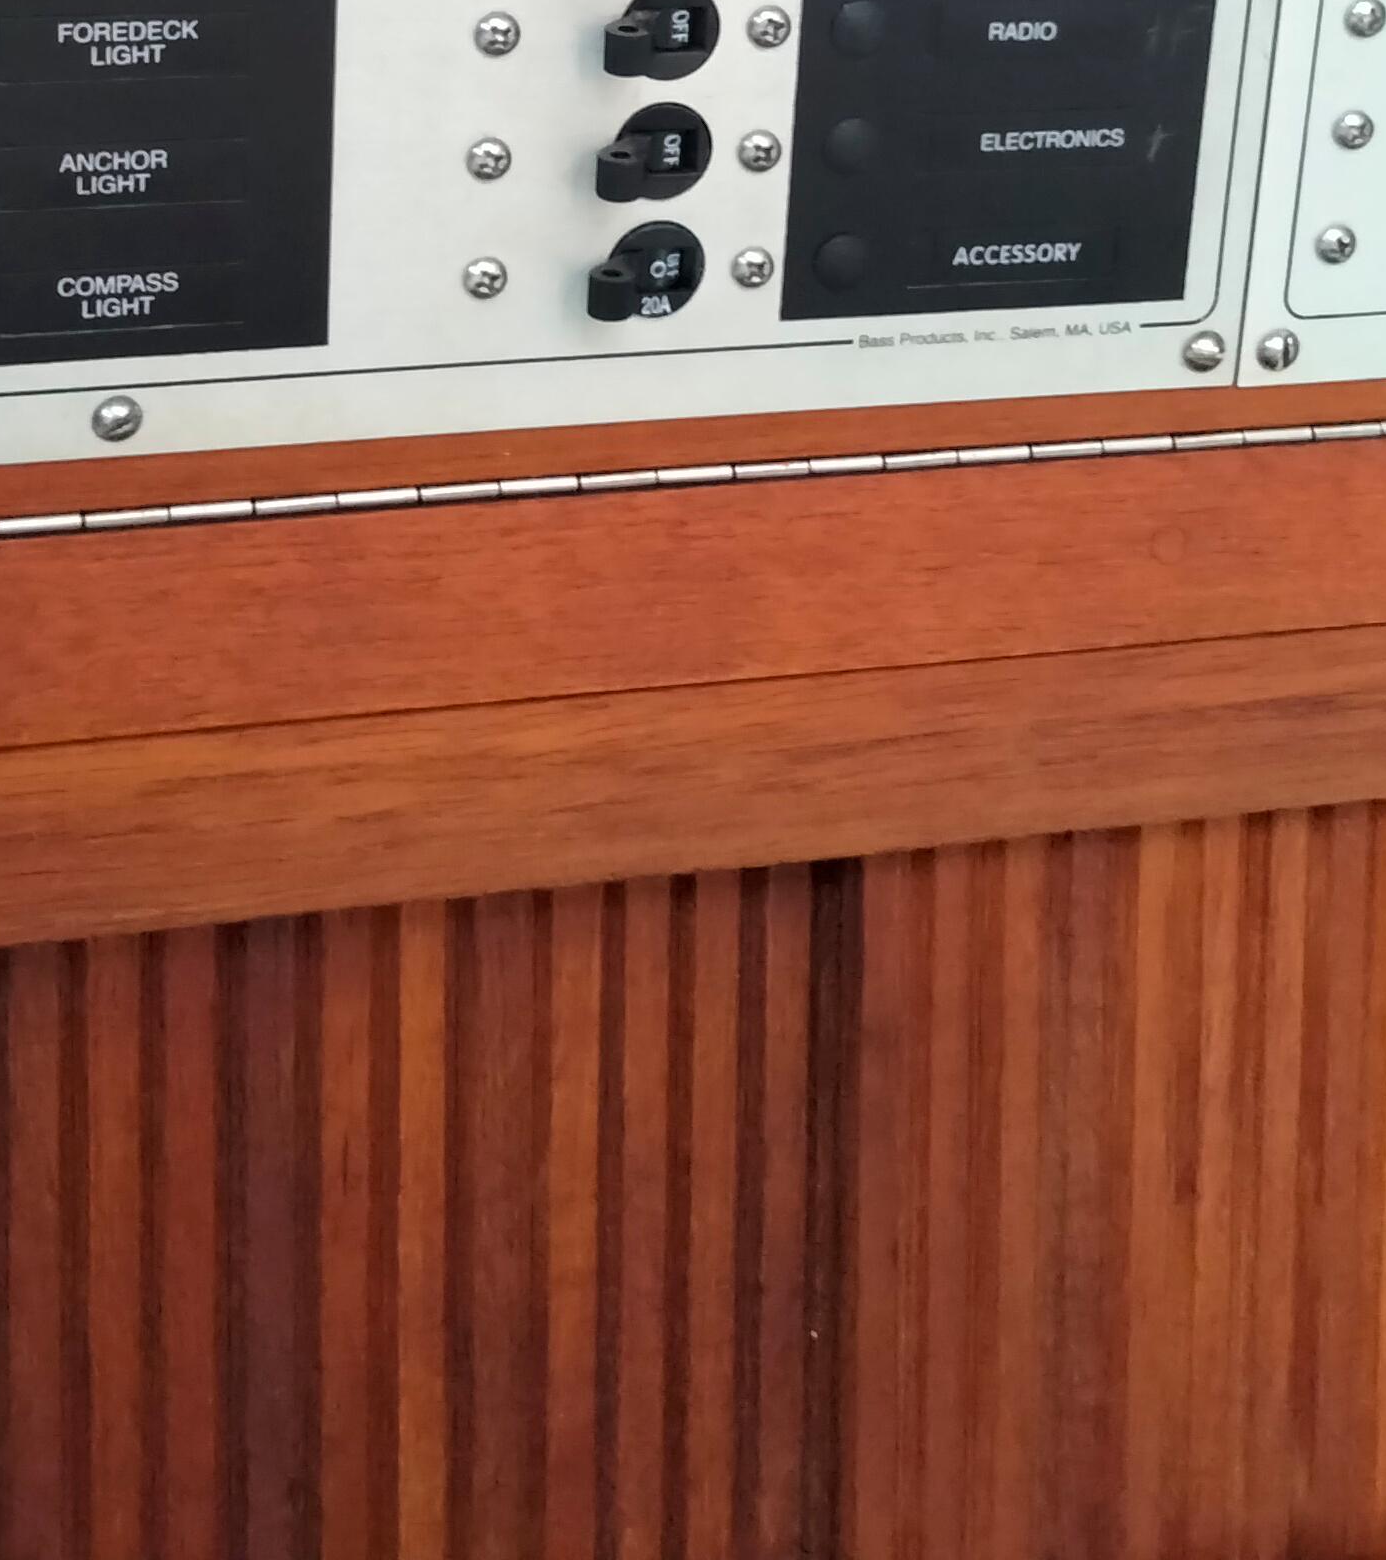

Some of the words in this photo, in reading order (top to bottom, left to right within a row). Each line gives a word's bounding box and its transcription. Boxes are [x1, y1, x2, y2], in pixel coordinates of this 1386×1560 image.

[57, 19, 200, 44] FOREDECK
[670, 8, 690, 44] OFF
[988, 21, 1057, 42] RADIO
[90, 43, 167, 67] LIGHT
[663, 133, 682, 167] OFF
[979, 127, 1126, 152] ELECTRONICS
[58, 148, 169, 174] ANCHOR
[75, 172, 151, 196] LIGHT
[952, 241, 1083, 266] ACCESSORY
[56, 271, 180, 297] COMPASS
[81, 295, 156, 320] LIGHT
[641, 294, 672, 315] 20A
[1099, 321, 1132, 335] USA
